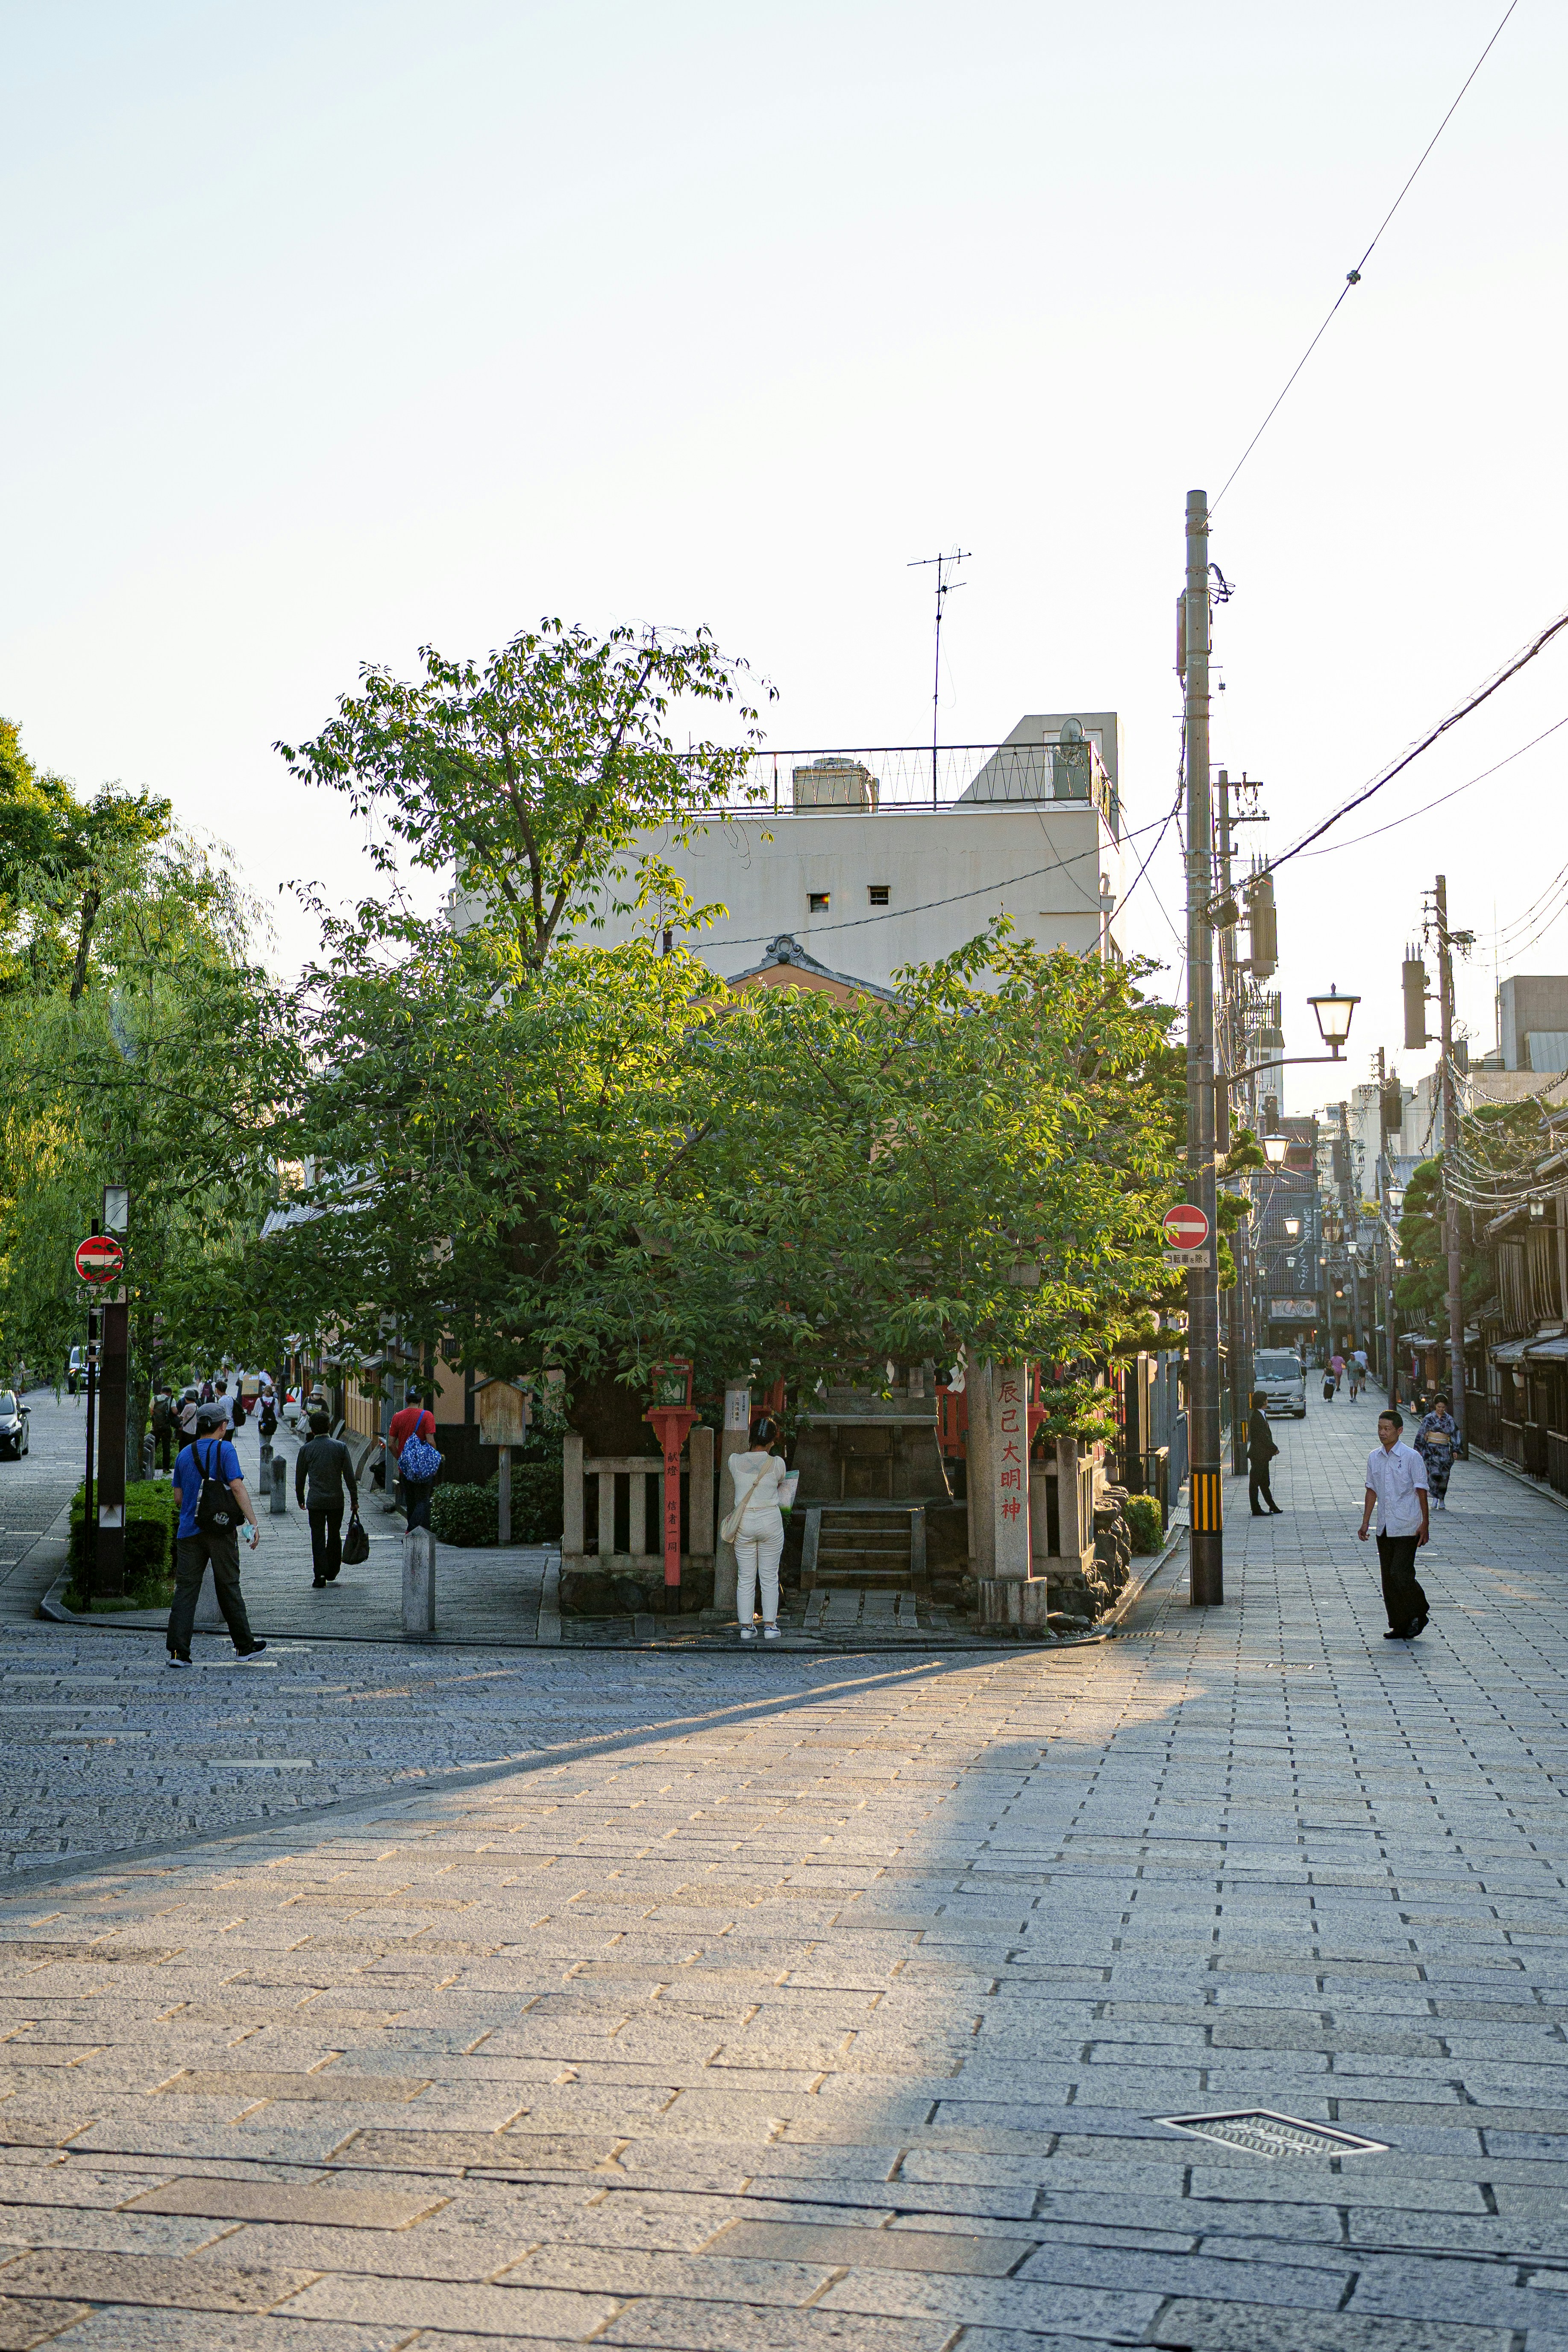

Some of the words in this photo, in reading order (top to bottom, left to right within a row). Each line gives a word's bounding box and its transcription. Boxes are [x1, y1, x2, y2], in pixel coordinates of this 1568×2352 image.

[1166, 1254, 1208, 1264] 自転車を除く
[1274, 1301, 1313, 1317] PICASSO
[667, 1452, 678, 1476] 献燈
[667, 1501, 677, 1552] 信者一同
